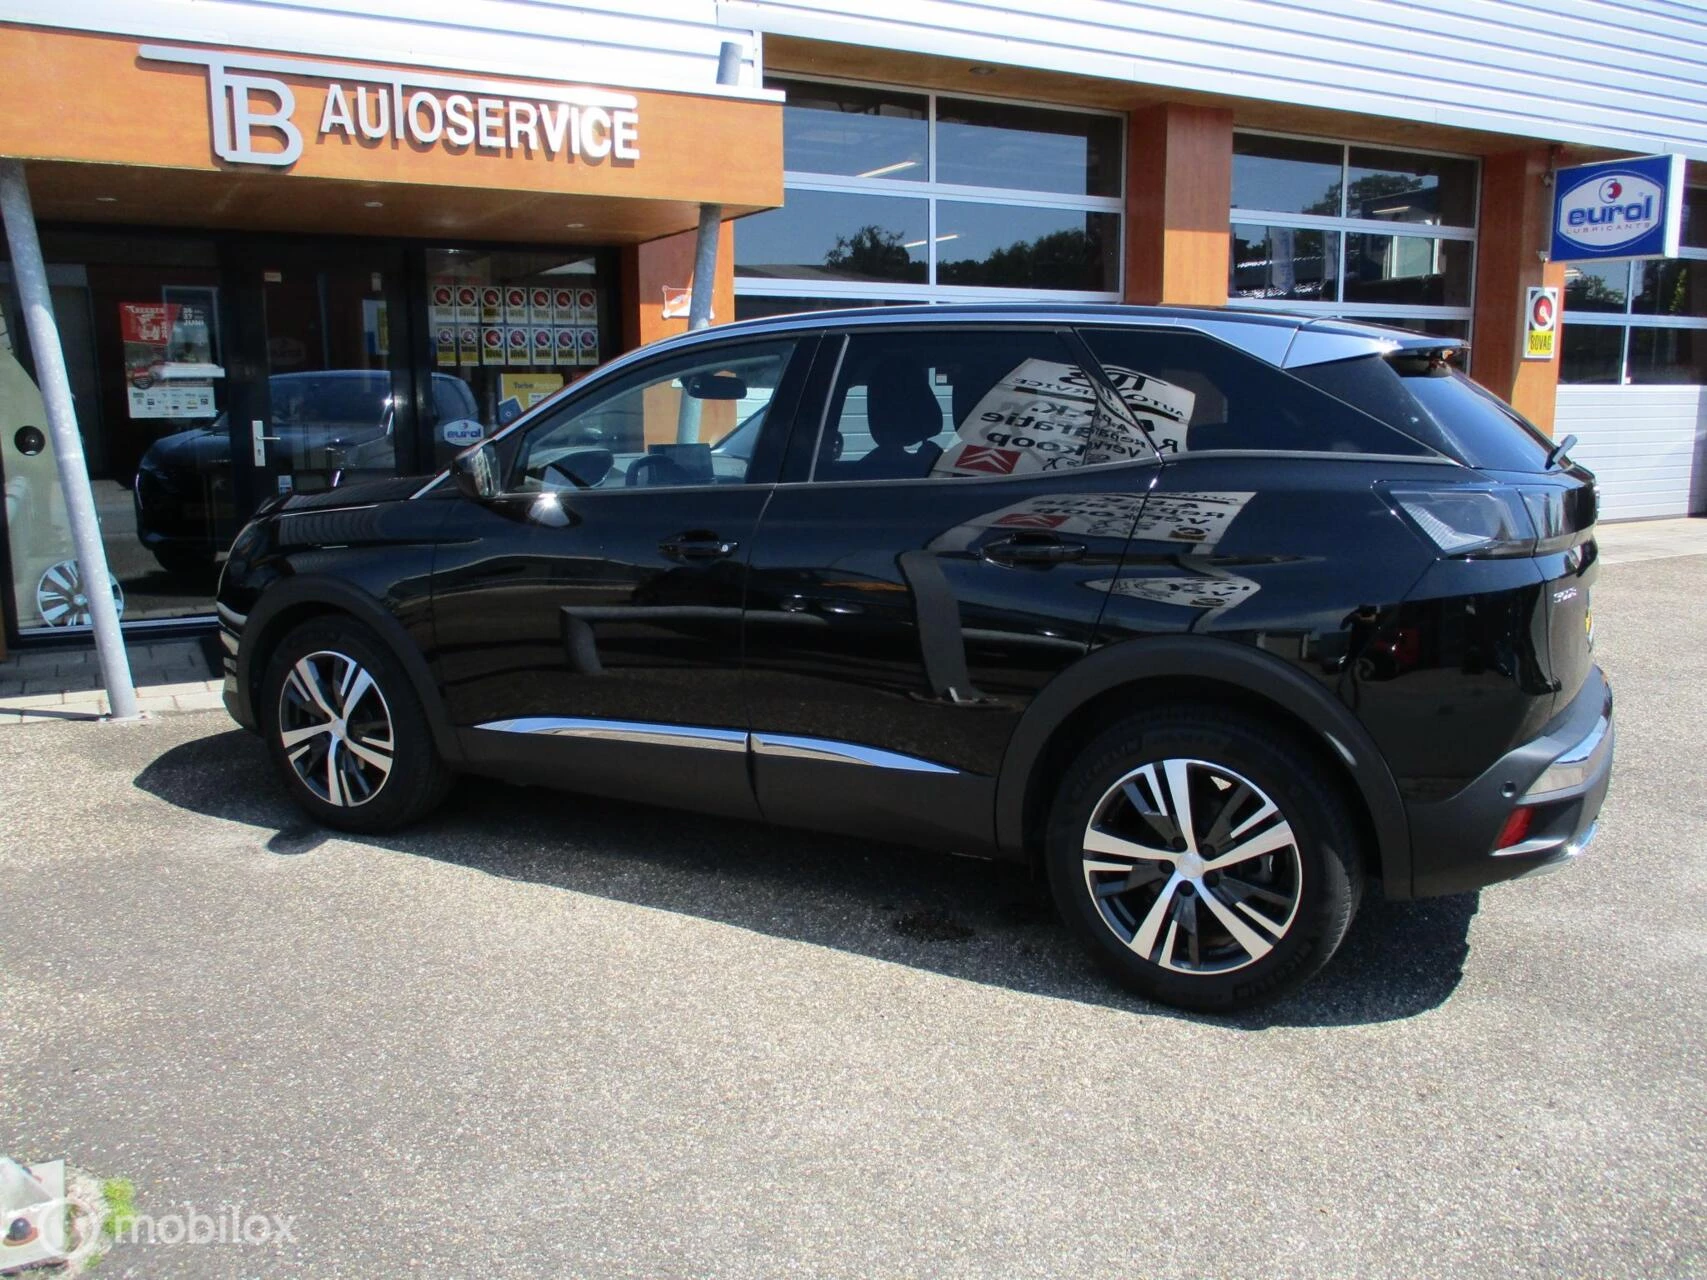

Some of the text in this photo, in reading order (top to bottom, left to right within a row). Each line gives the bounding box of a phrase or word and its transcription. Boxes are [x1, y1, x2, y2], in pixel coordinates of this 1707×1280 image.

[319, 79, 640, 160] AUTOSERVICE
[1566, 222, 1651, 234] LUBRICANTS
[1568, 195, 1653, 228] eurol
